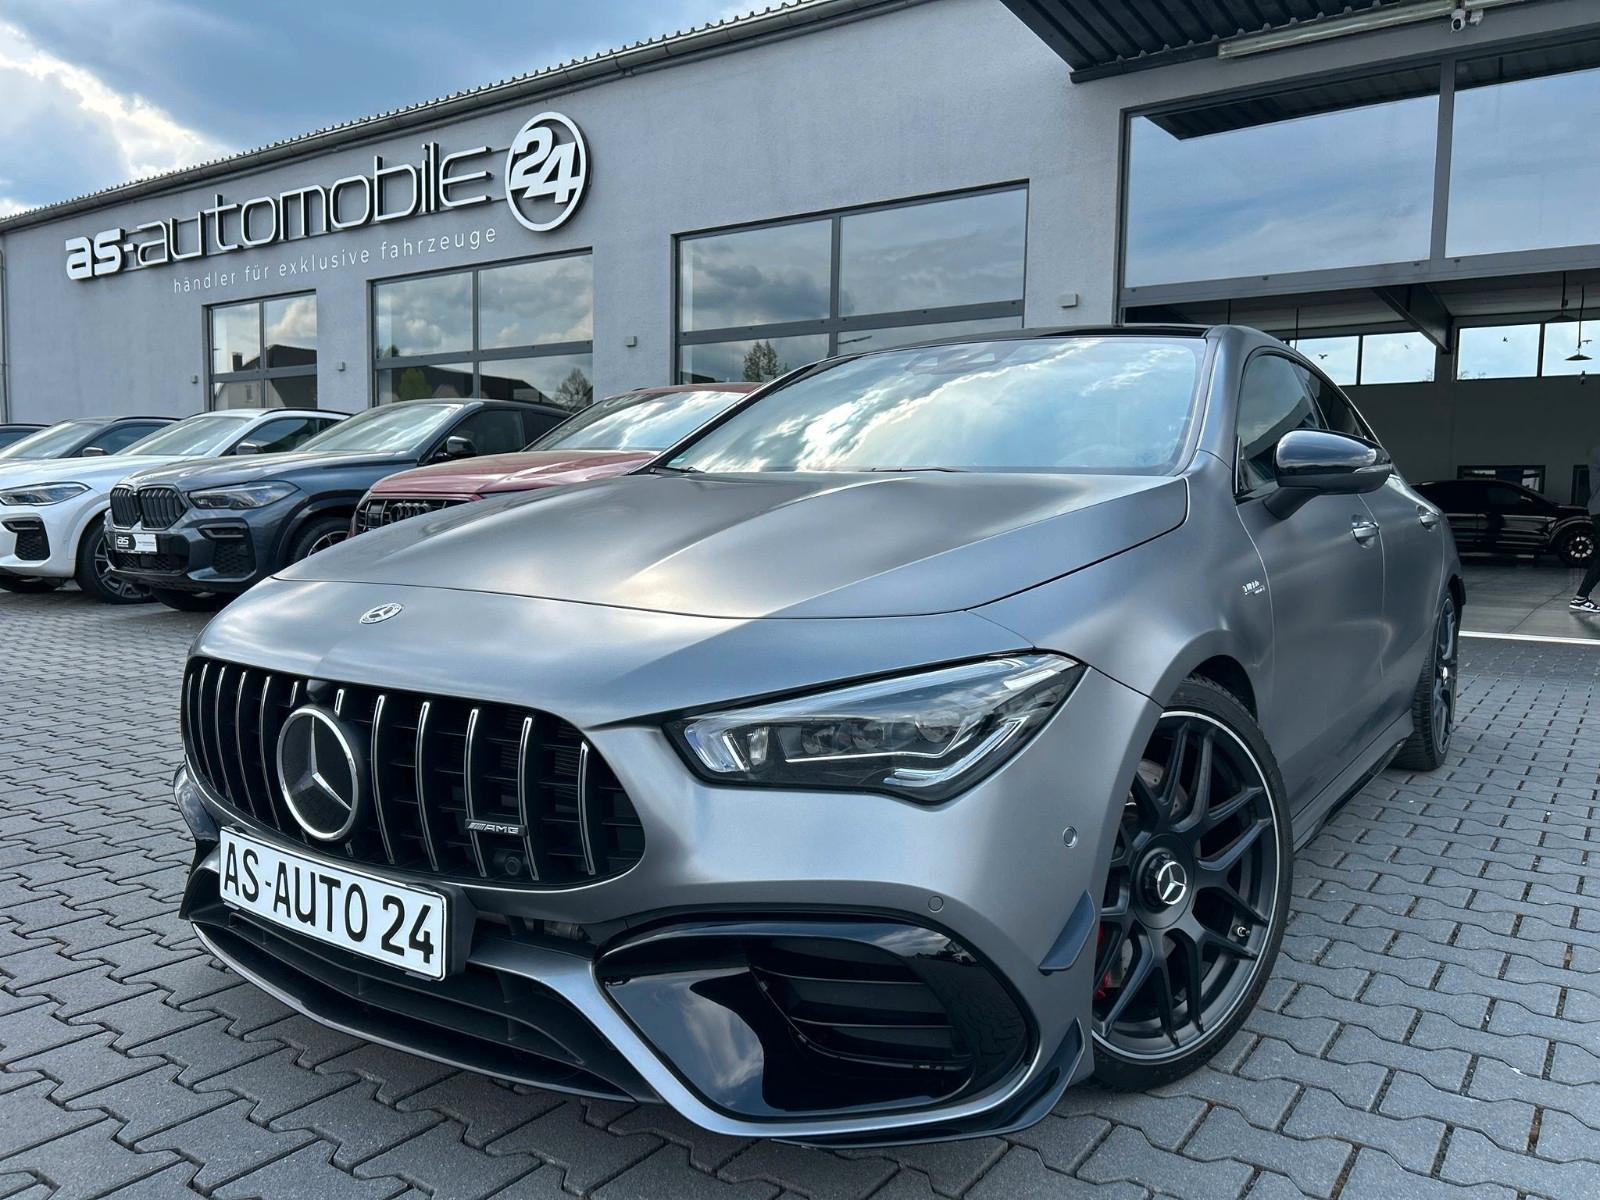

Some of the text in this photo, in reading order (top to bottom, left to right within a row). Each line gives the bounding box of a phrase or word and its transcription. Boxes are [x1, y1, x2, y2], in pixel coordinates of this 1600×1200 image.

[509, 126, 581, 204] 24
[173, 227, 496, 294] händler für exklusive fahrzeuge
[224, 841, 434, 965] AS-AUTO 24
